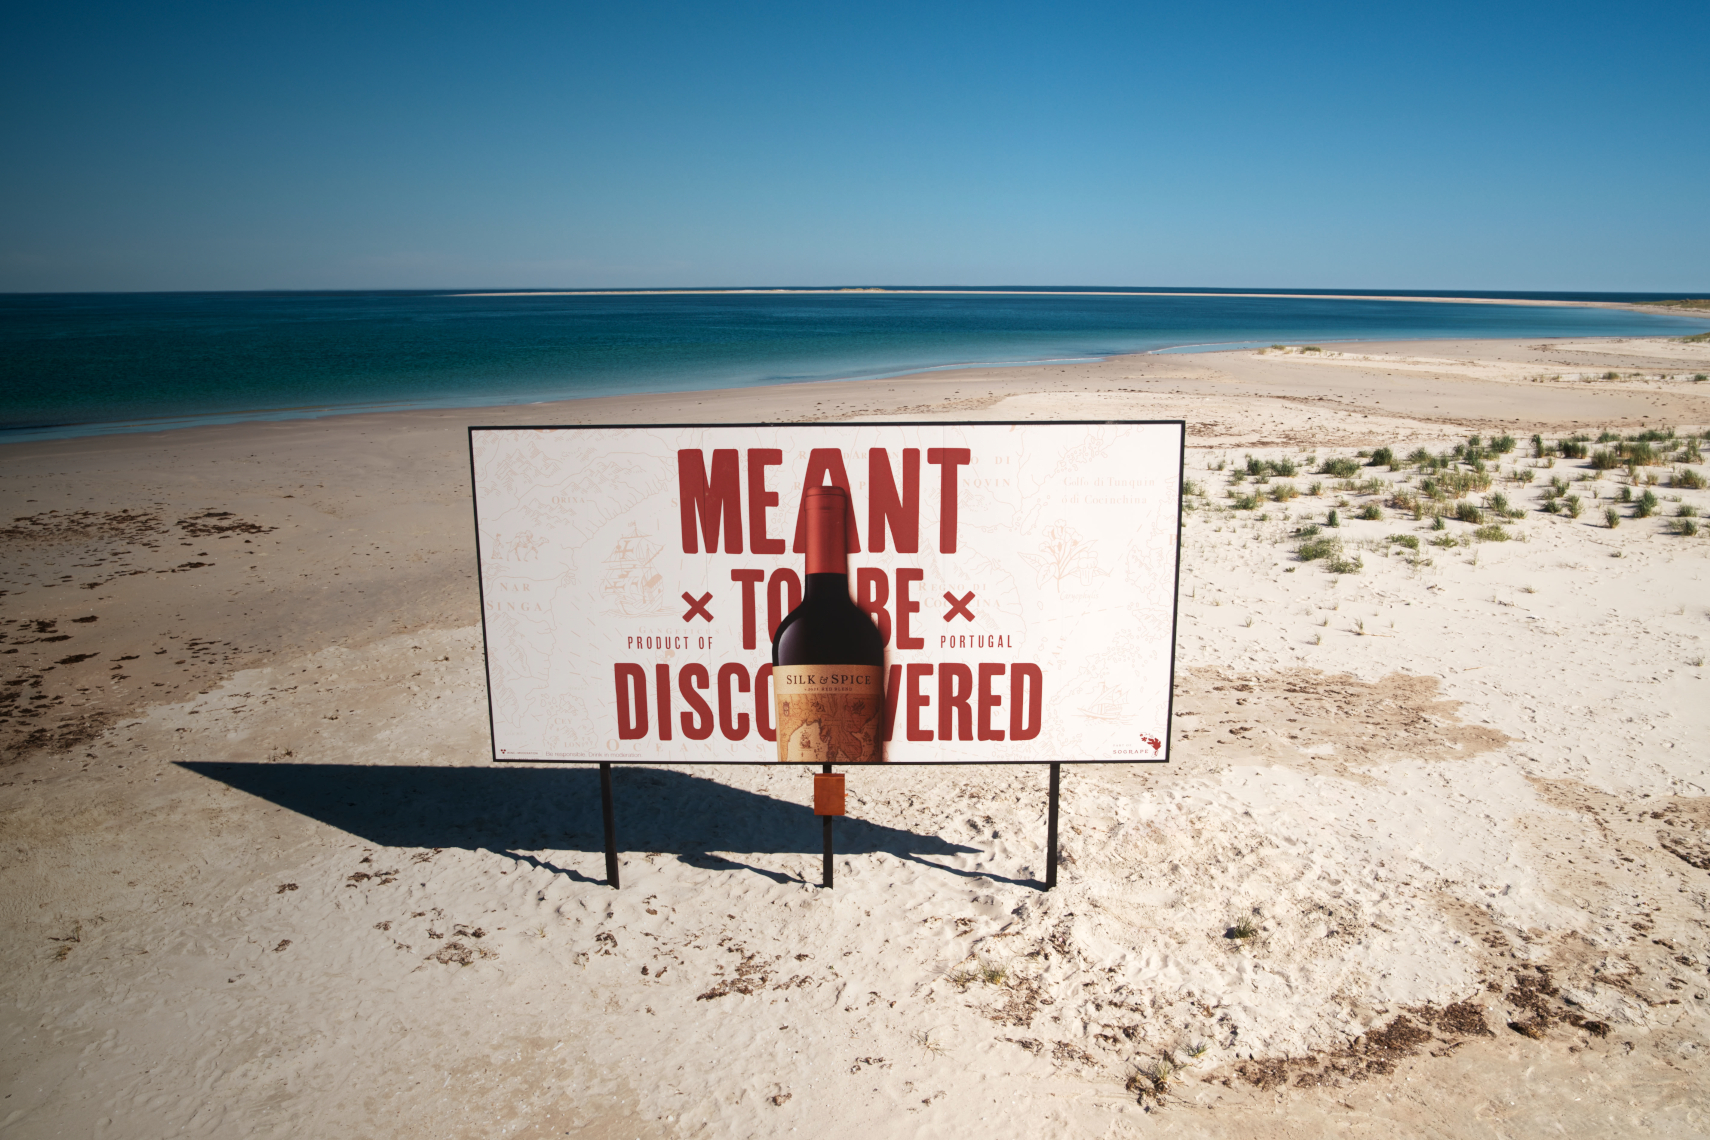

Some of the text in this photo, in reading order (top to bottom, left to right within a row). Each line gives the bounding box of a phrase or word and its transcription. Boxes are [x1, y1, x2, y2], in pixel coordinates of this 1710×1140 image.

[1094, 477, 1104, 486] di
[1107, 477, 1155, 489] Tunquin
[678, 448, 971, 554] MEANT
[1085, 494, 1147, 504] Cocinchina
[500, 582, 530, 592] NAR
[918, 582, 986, 592] REGNO DI
[486, 600, 543, 611] SINGA
[731, 568, 801, 650] TO
[857, 568, 925, 650] BE
[627, 636, 713, 649] PRODUCT OF
[940, 634, 1013, 649] PORTUGAL
[786, 674, 872, 685] SILK & SPICE
